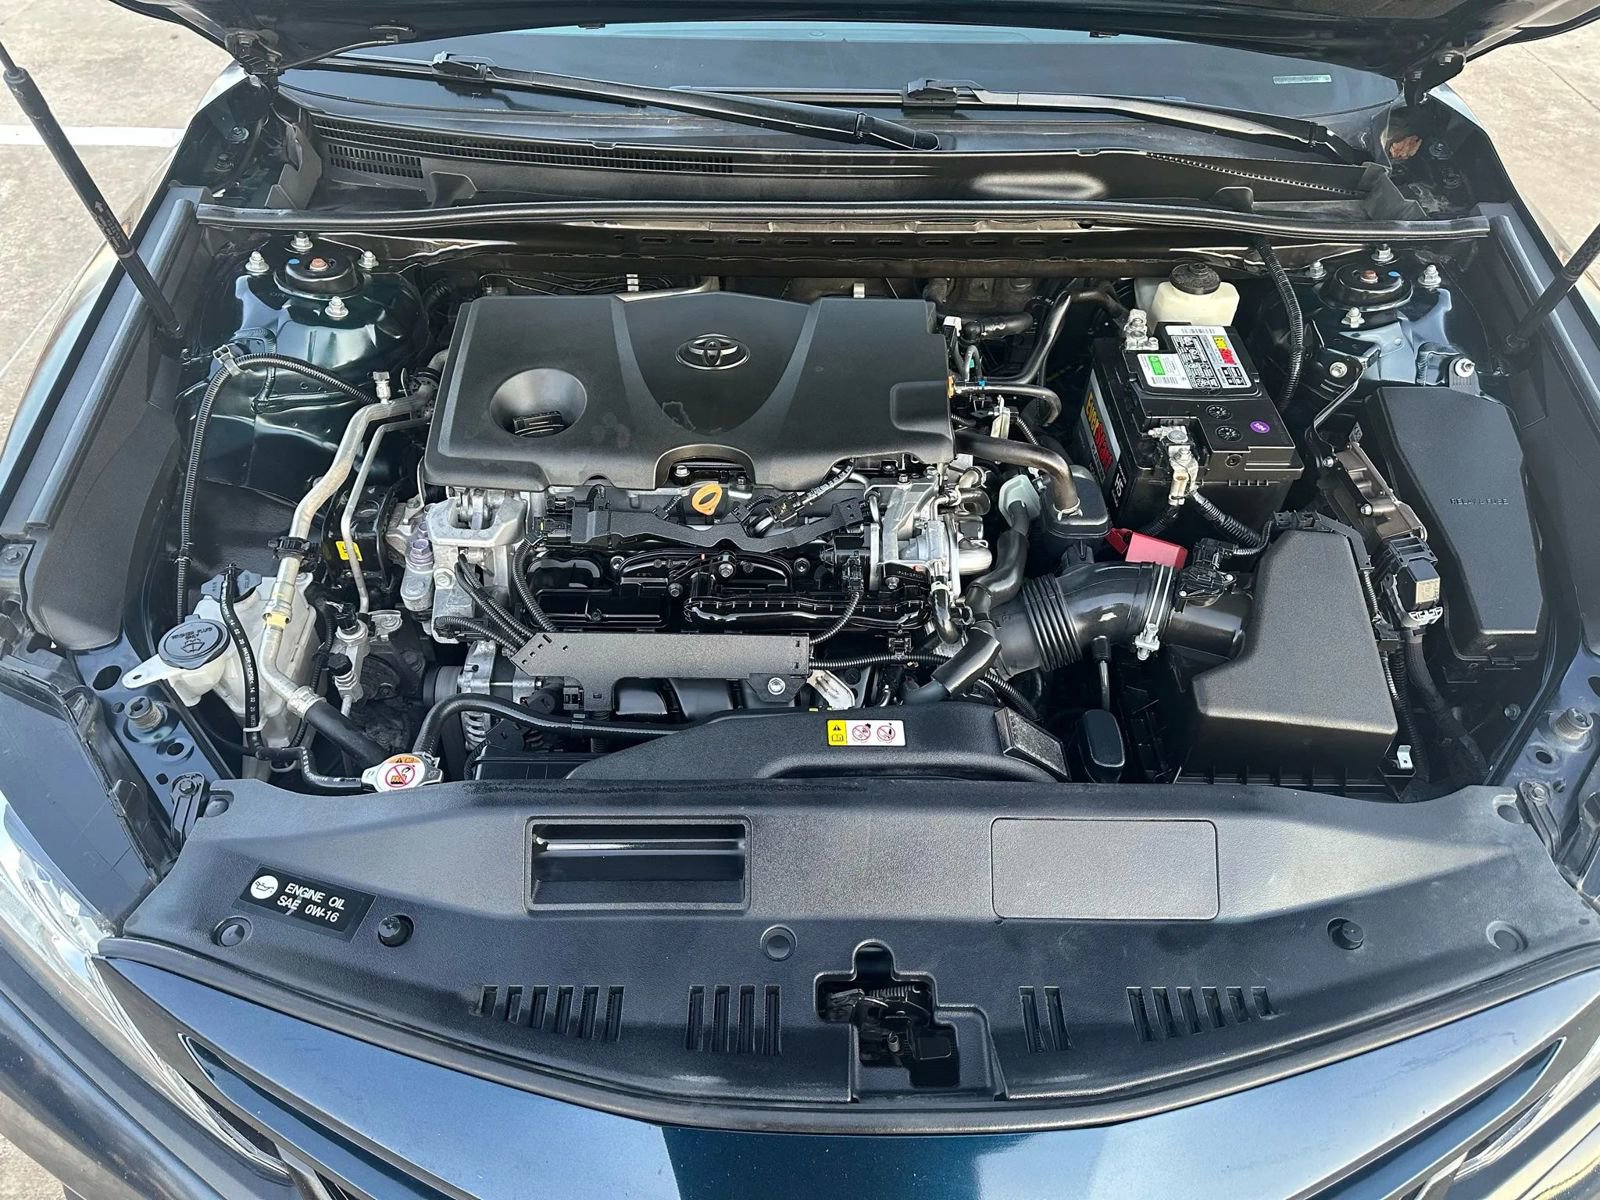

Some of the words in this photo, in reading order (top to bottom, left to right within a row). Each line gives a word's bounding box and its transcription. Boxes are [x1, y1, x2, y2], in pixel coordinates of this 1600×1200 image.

[276, 895, 302, 910] SAE
[304, 904, 340, 922] 0W-16
[284, 882, 326, 903] ENGINE
[328, 896, 346, 910] OIL
